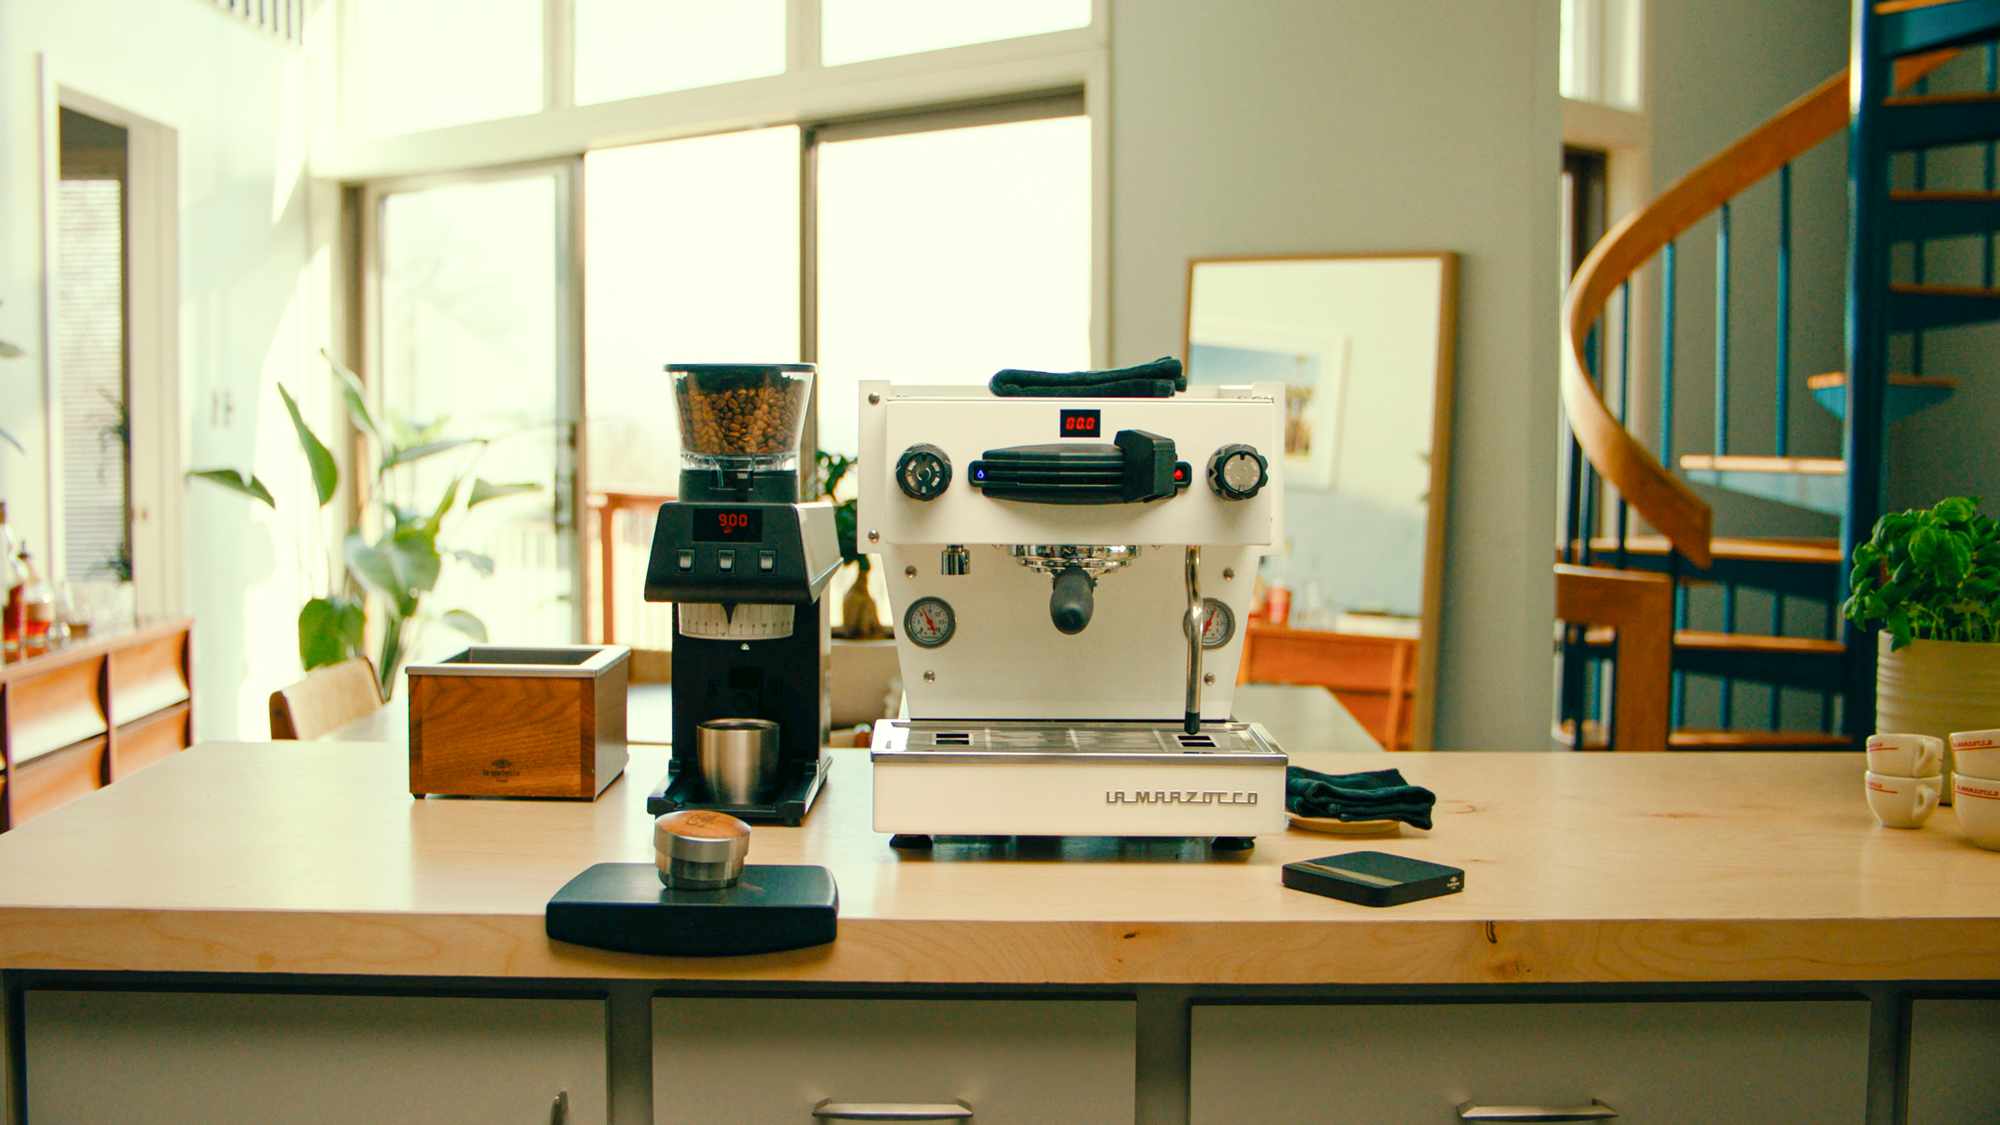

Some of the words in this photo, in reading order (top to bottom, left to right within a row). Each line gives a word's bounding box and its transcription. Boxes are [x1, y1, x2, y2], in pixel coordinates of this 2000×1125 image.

[1065, 416, 1096, 430] 00.0
[1106, 791, 1125, 804] LA
[1135, 791, 1259, 805] MARZOCCO
